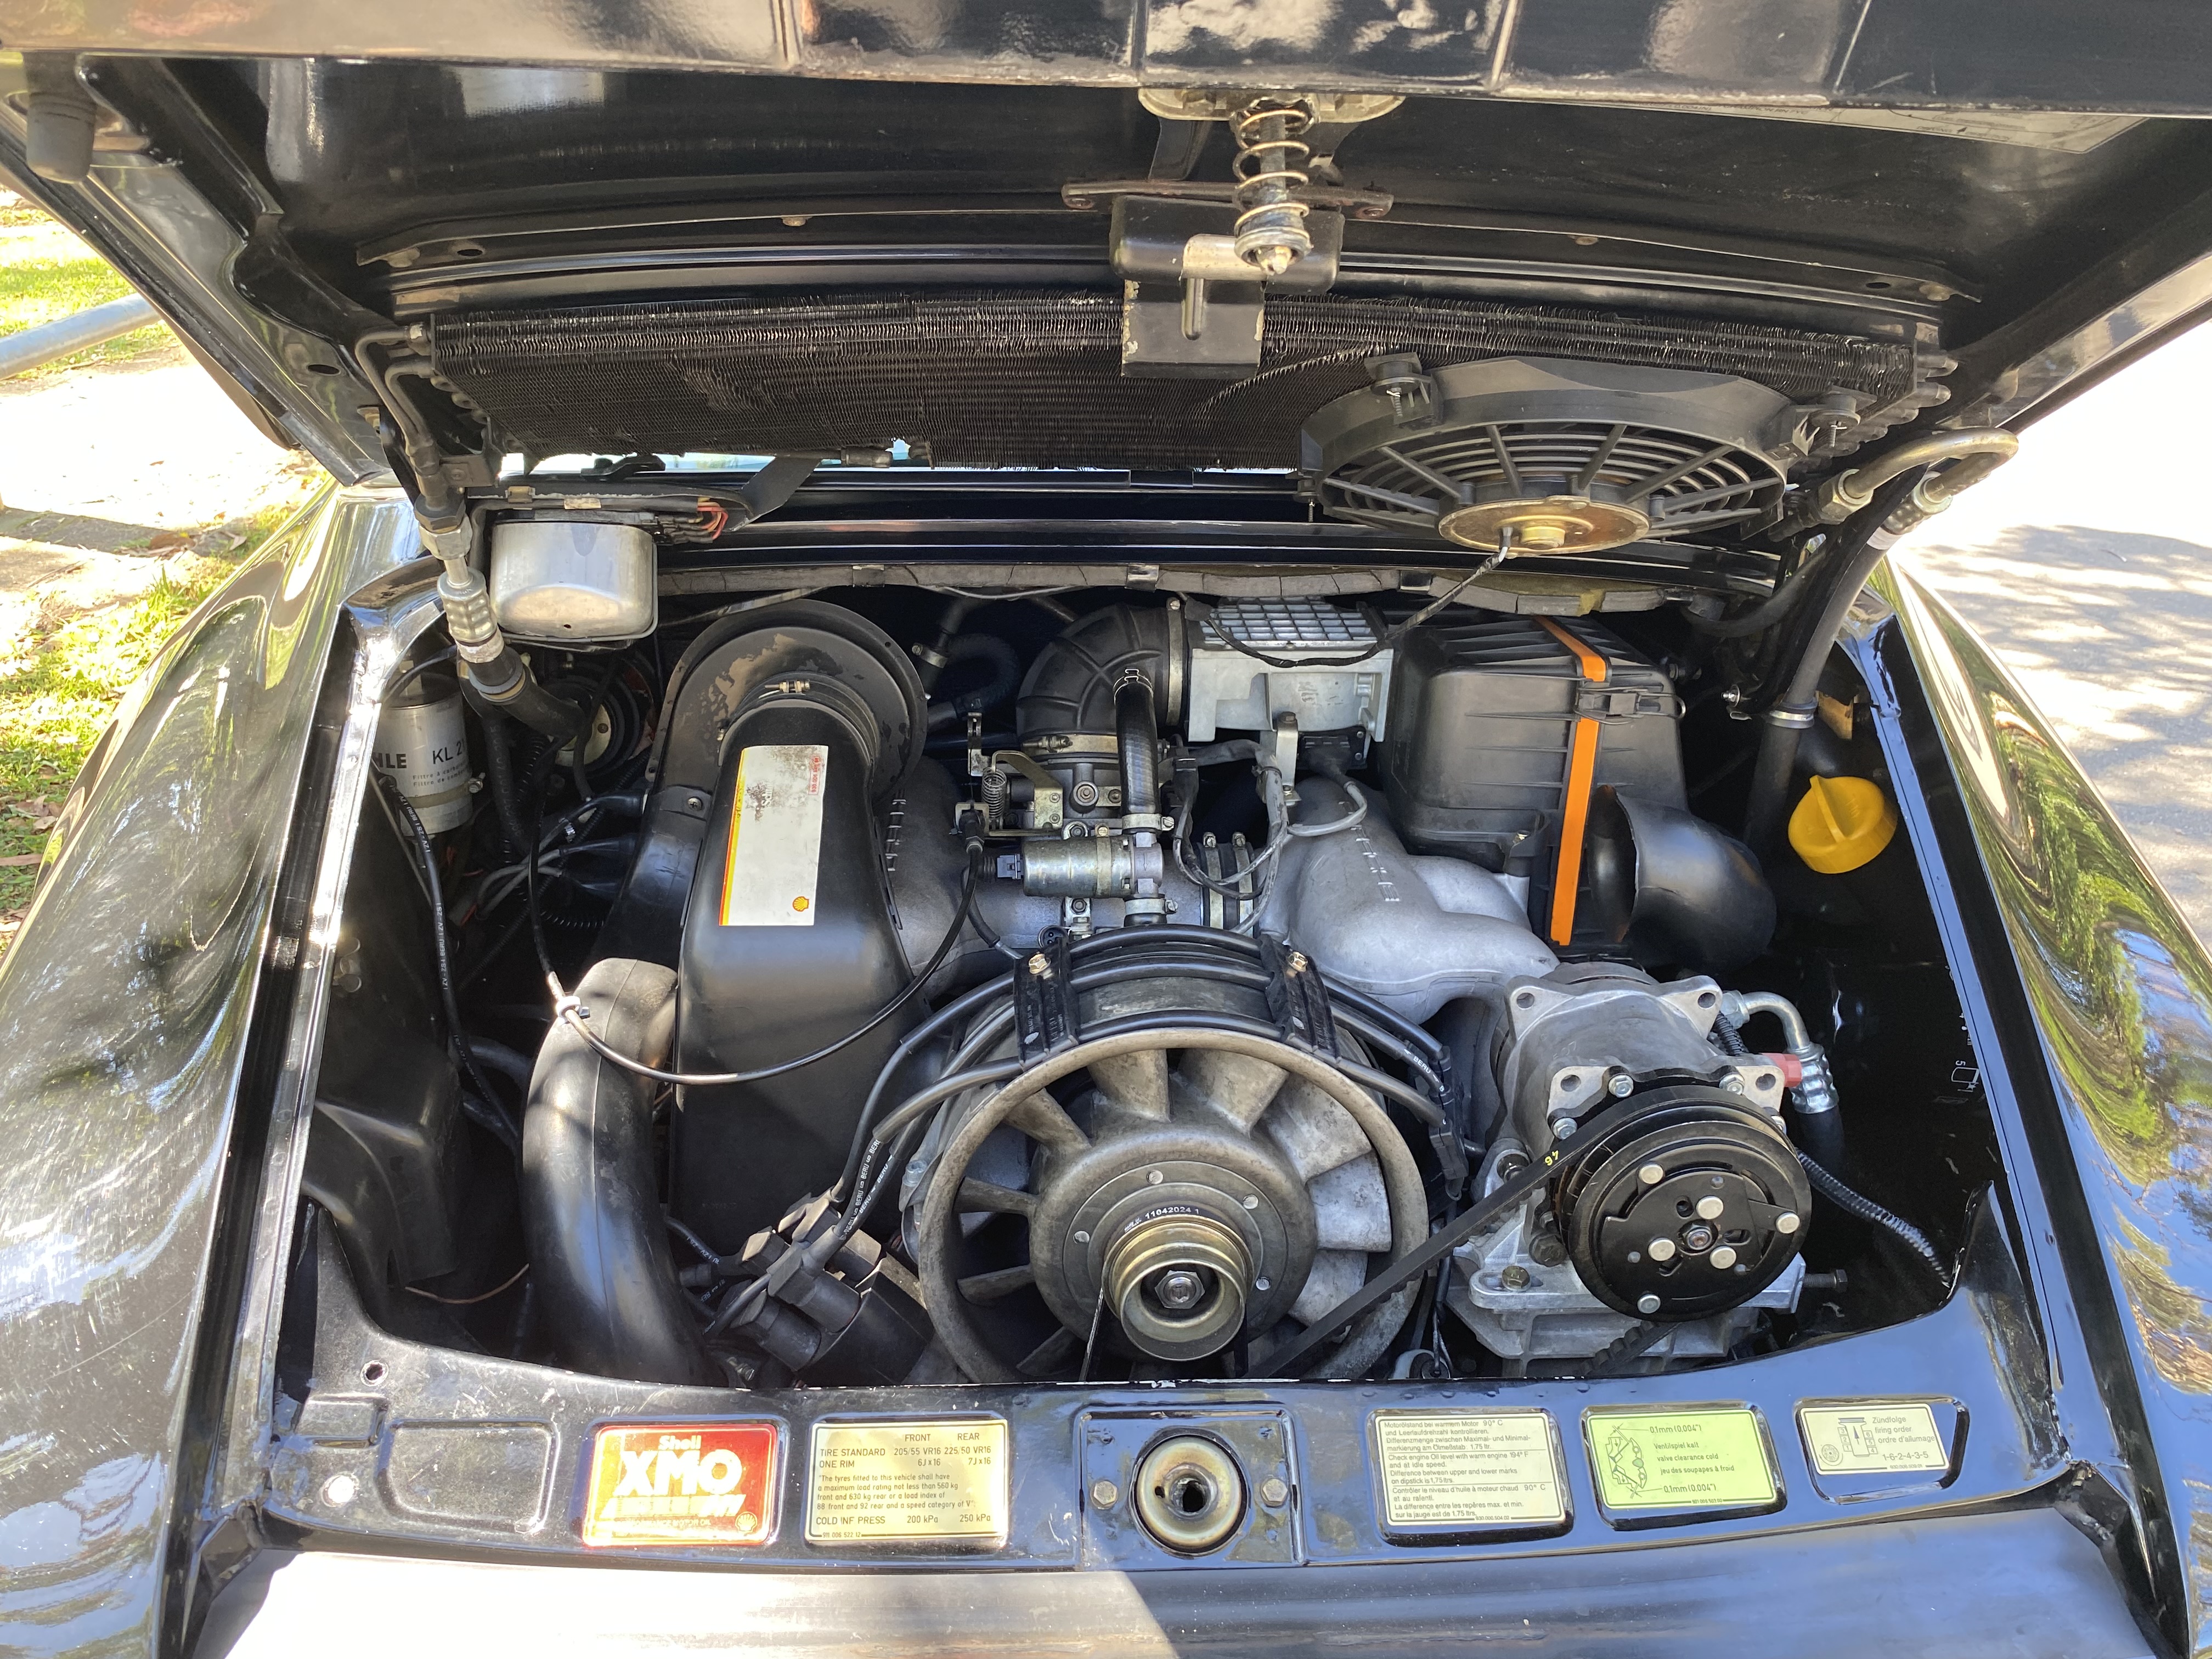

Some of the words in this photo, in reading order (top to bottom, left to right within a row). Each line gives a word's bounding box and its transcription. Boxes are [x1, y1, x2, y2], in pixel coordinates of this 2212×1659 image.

[433, 747, 453, 764] KL
[1413, 1056, 1431, 1074] BERU
[855, 1190, 864, 1206] BERU
[860, 1164, 870, 1180] BERU
[1145, 1206, 1191, 1219] 11042024
[659, 1435, 701, 1450] Shell
[905, 1434, 930, 1442] FRONT
[821, 1448, 838, 1457] TIRE
[841, 1448, 885, 1457] STANDARD
[1882, 1453, 1929, 1461] 1-6-2-4-3-5
[613, 1449, 742, 1497] XMO
[873, 1483, 891, 1492] rating
[951, 1482, 958, 1490] kg
[864, 1493, 871, 1501] kg
[907, 1502, 926, 1510] speed
[928, 1500, 955, 1509] category
[816, 1517, 838, 1525] COLD
[840, 1516, 854, 1525] INF
[858, 1516, 885, 1525] PRESS
[907, 1515, 921, 1523] 200
[924, 1515, 938, 1523] kPa
[960, 1514, 973, 1522] 250
[1413, 1510, 1431, 1519] jauge
